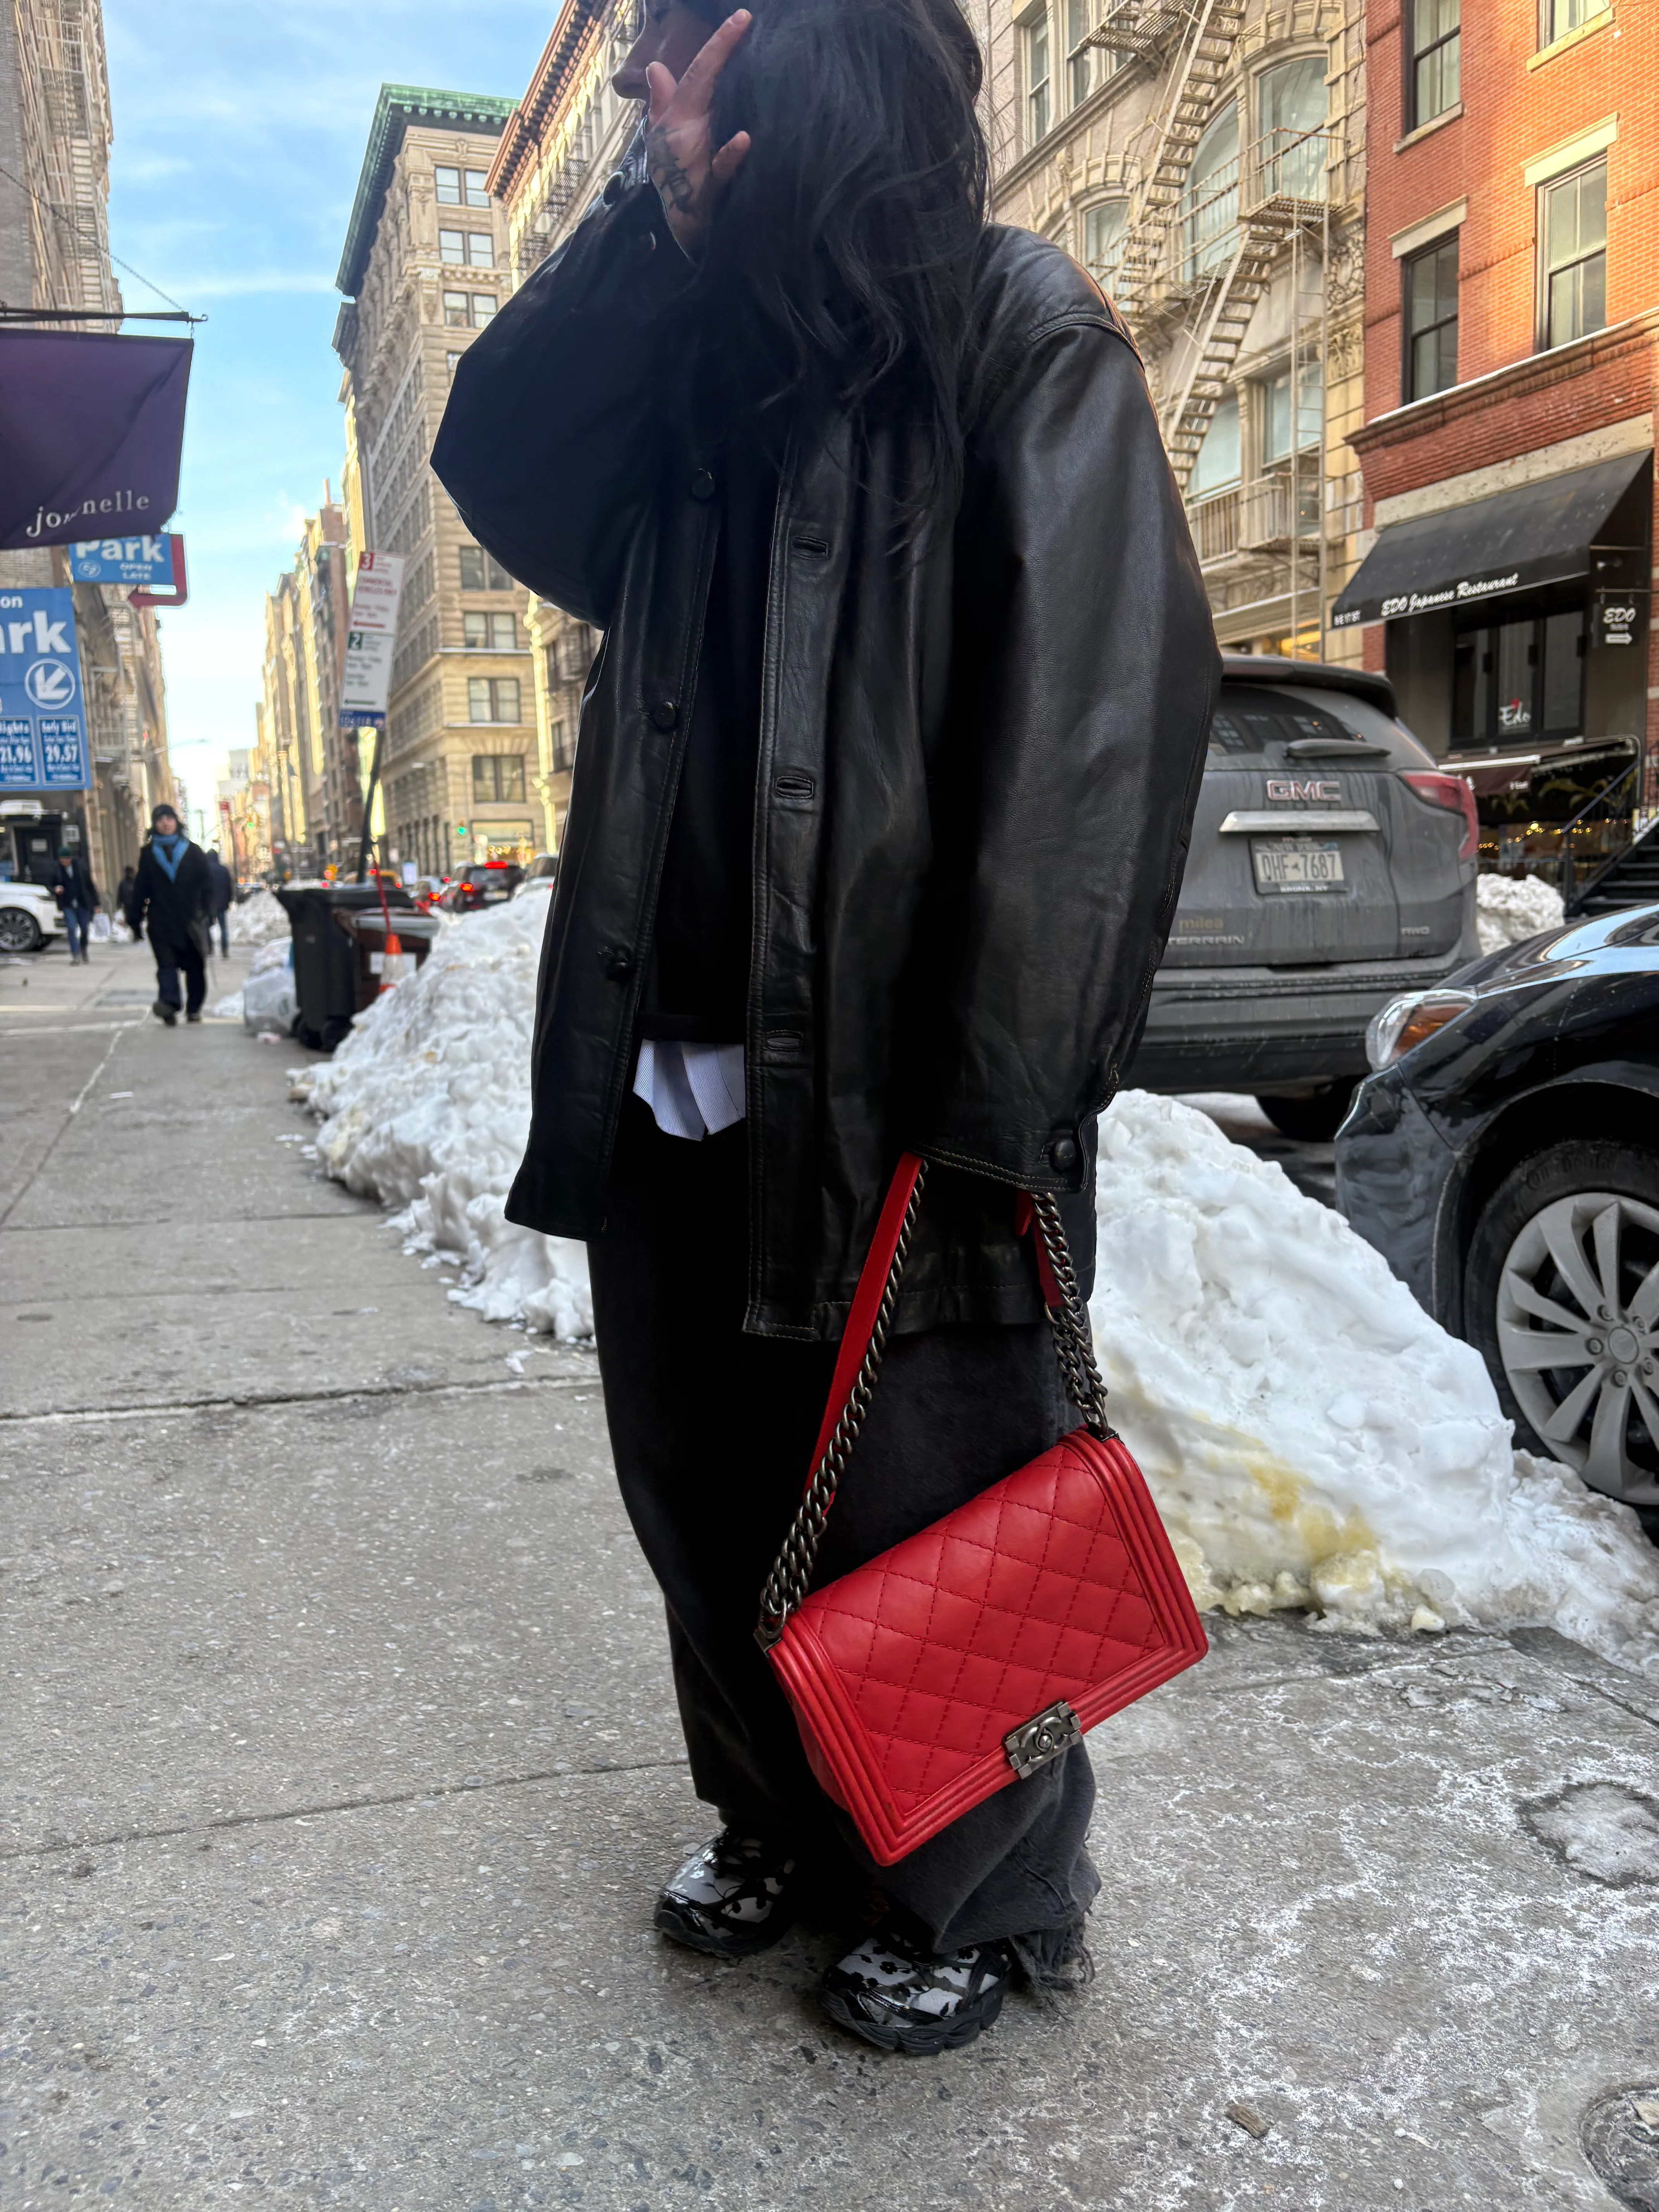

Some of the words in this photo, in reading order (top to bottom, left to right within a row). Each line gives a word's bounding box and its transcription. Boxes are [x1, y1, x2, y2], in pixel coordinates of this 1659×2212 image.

[76, 534, 165, 563] Park
[120, 562, 152, 571] OPEN
[361, 553, 370, 568] 3
[122, 571, 151, 580] LATE
[0, 596, 23, 608] on
[1381, 596, 1408, 617] EDO
[1408, 590, 1455, 613] Japanese
[1456, 572, 1518, 599] Restaurant
[1603, 607, 1636, 624] EDO
[0, 610, 72, 653] rk
[351, 632, 361, 649] 2
[1498, 701, 1531, 725] Edo
[0, 720, 29, 736] ights
[1267, 780, 1341, 801] GMC
[1300, 854, 1336, 878] 7687
[1401, 926, 1430, 935] AWD
[1168, 936, 1245, 945] TERRAIN
